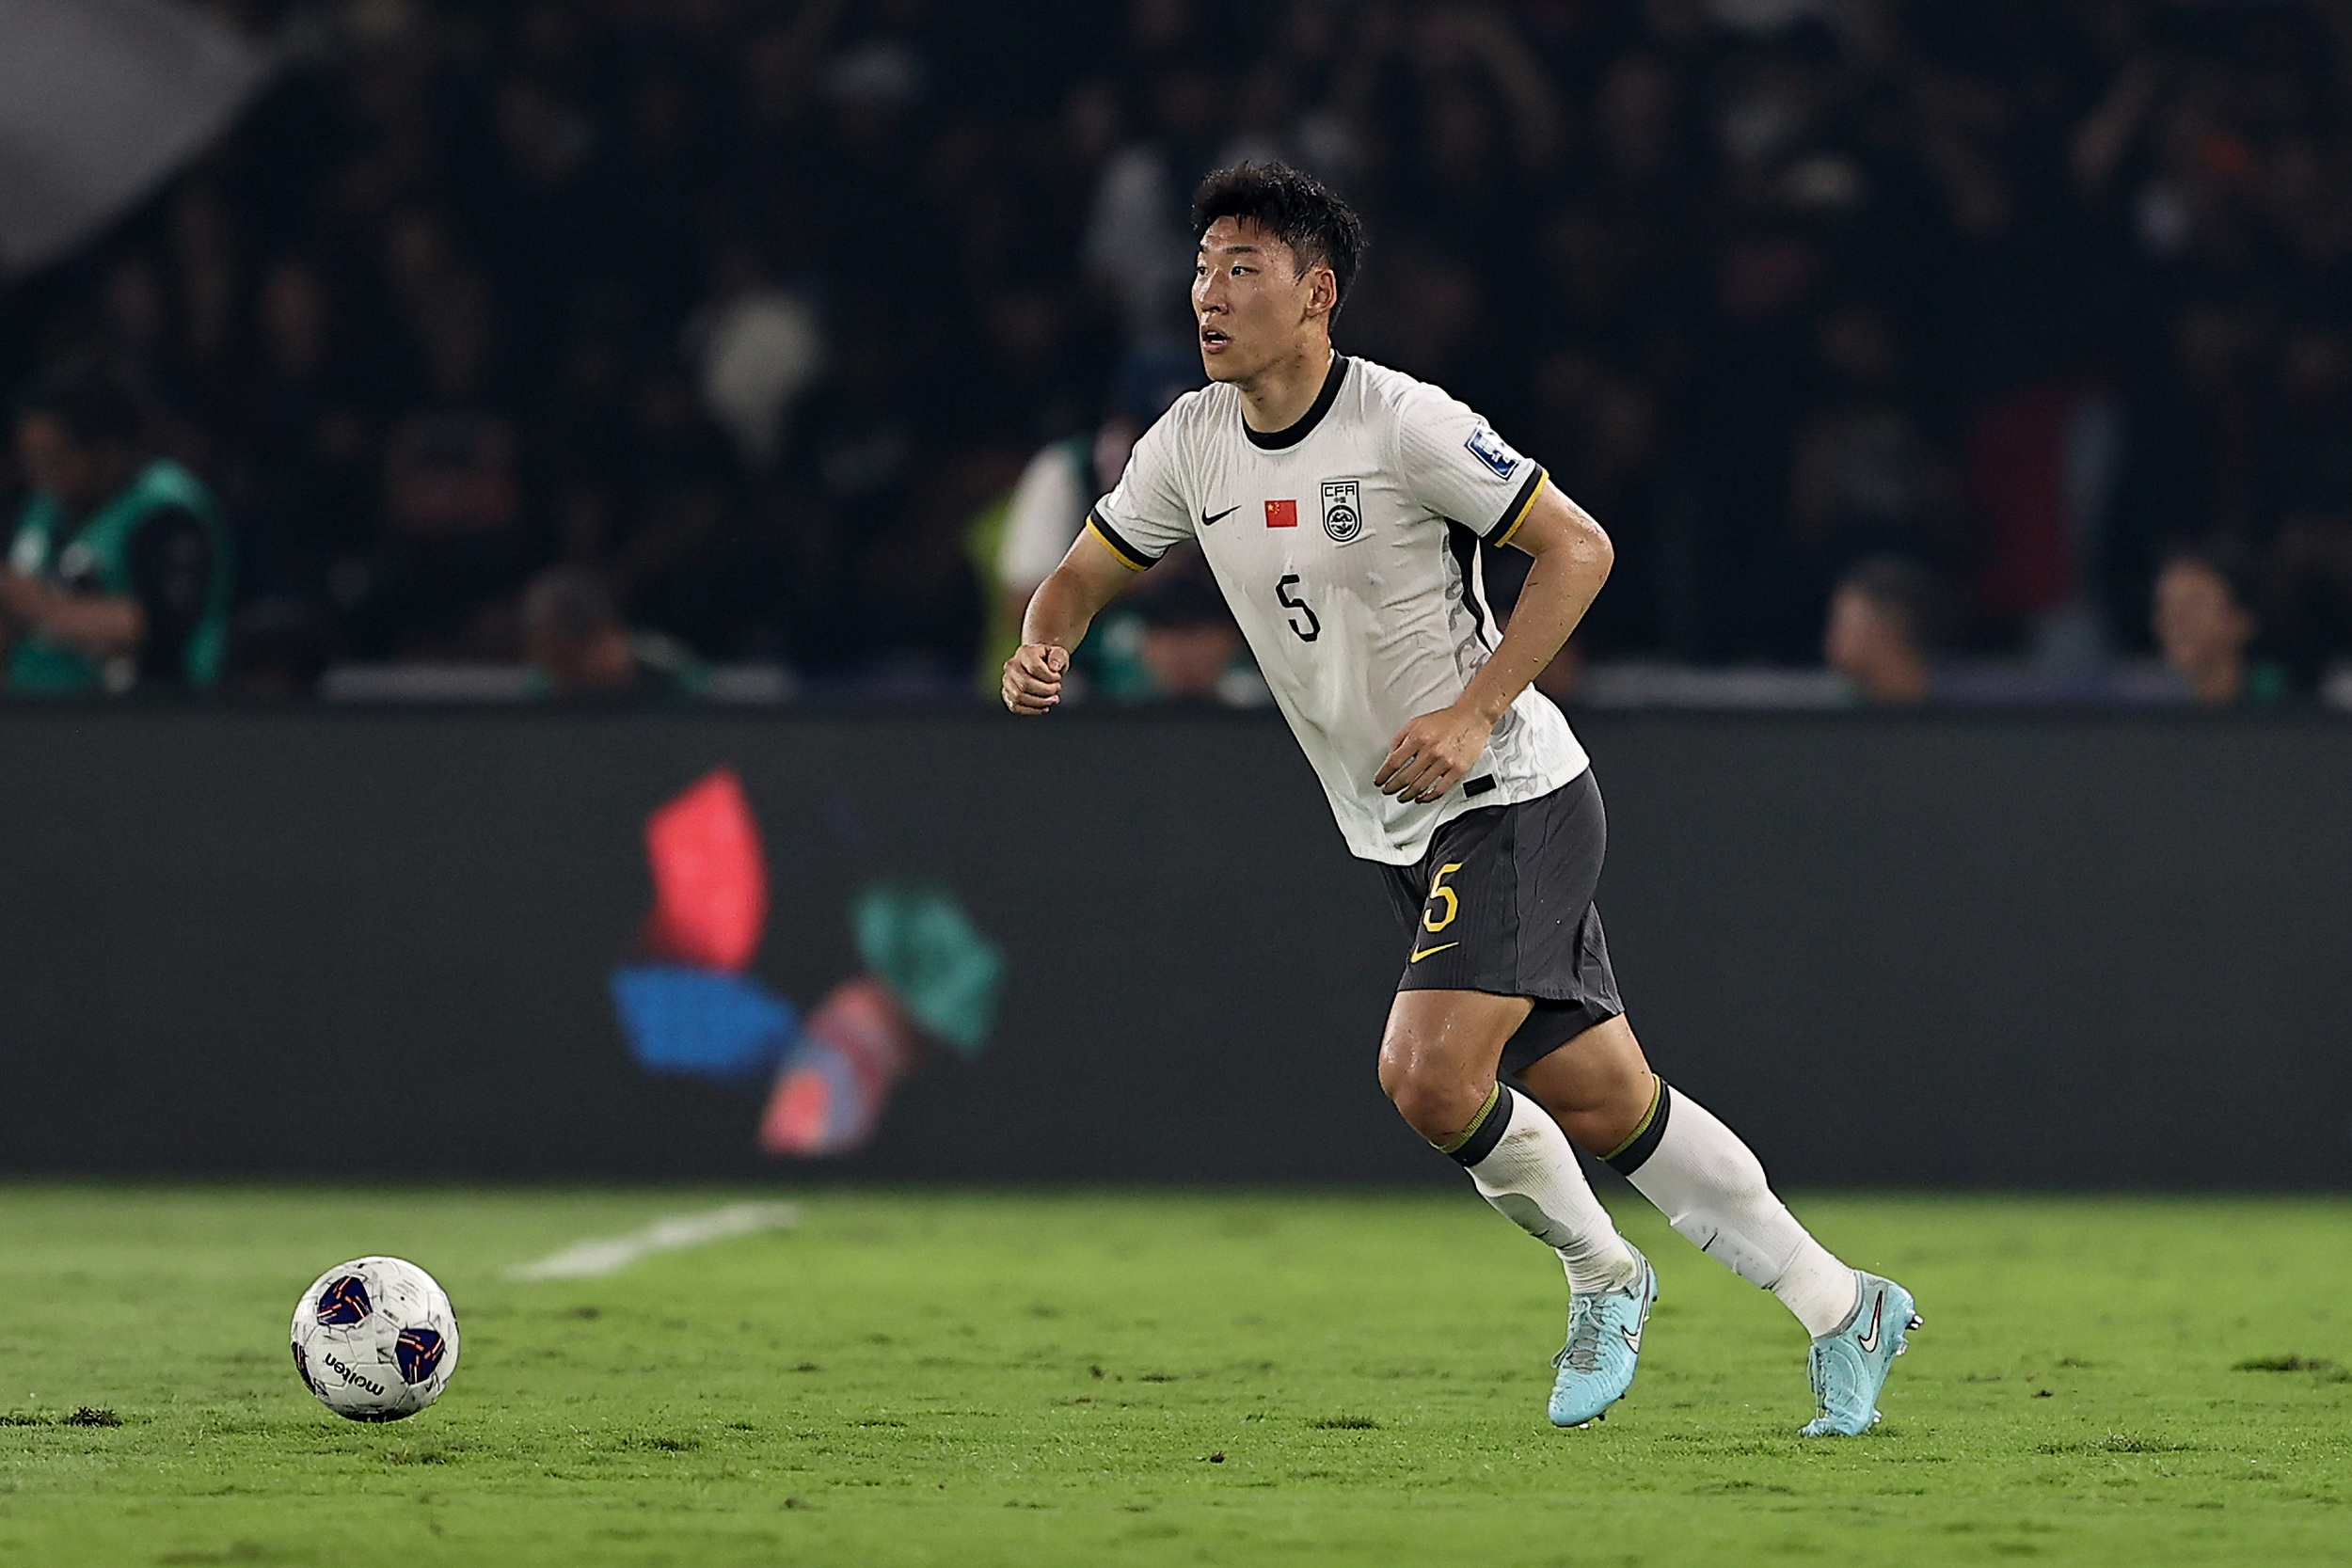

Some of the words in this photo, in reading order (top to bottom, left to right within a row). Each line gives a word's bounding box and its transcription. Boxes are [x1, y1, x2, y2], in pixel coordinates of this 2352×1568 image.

[1325, 484, 1355, 497] CFA
[1276, 574, 1321, 642] 5
[1423, 863, 1463, 932] 5
[325, 1353, 385, 1396] molten
